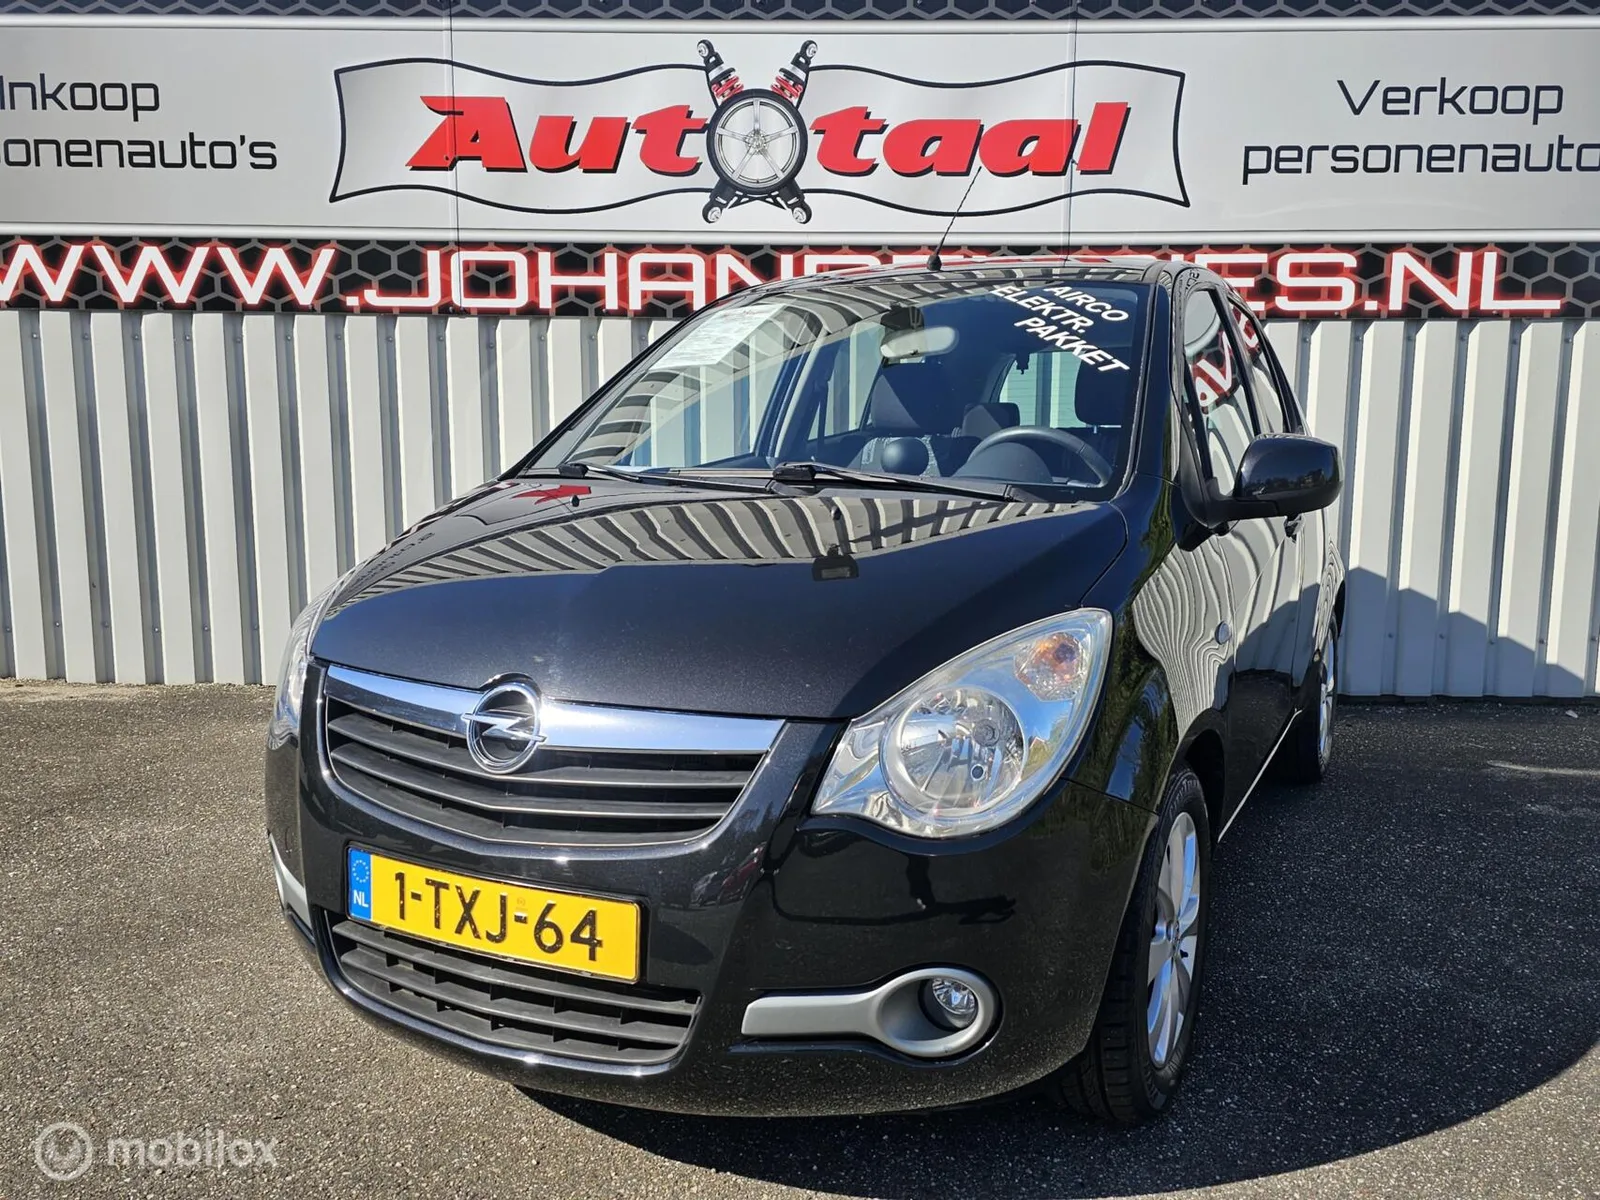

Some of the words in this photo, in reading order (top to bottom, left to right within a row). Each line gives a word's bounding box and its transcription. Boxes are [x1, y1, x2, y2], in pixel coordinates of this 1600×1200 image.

[1337, 77, 1564, 126] Verkoop
[0, 132, 278, 170] onenauto's
[990, 285, 1094, 334] ELEKTR.
[1043, 286, 1129, 322] AIRCO
[1014, 316, 1130, 373] PAKKET
[353, 889, 369, 908] NL
[395, 872, 603, 962] 1-TXJ-64
